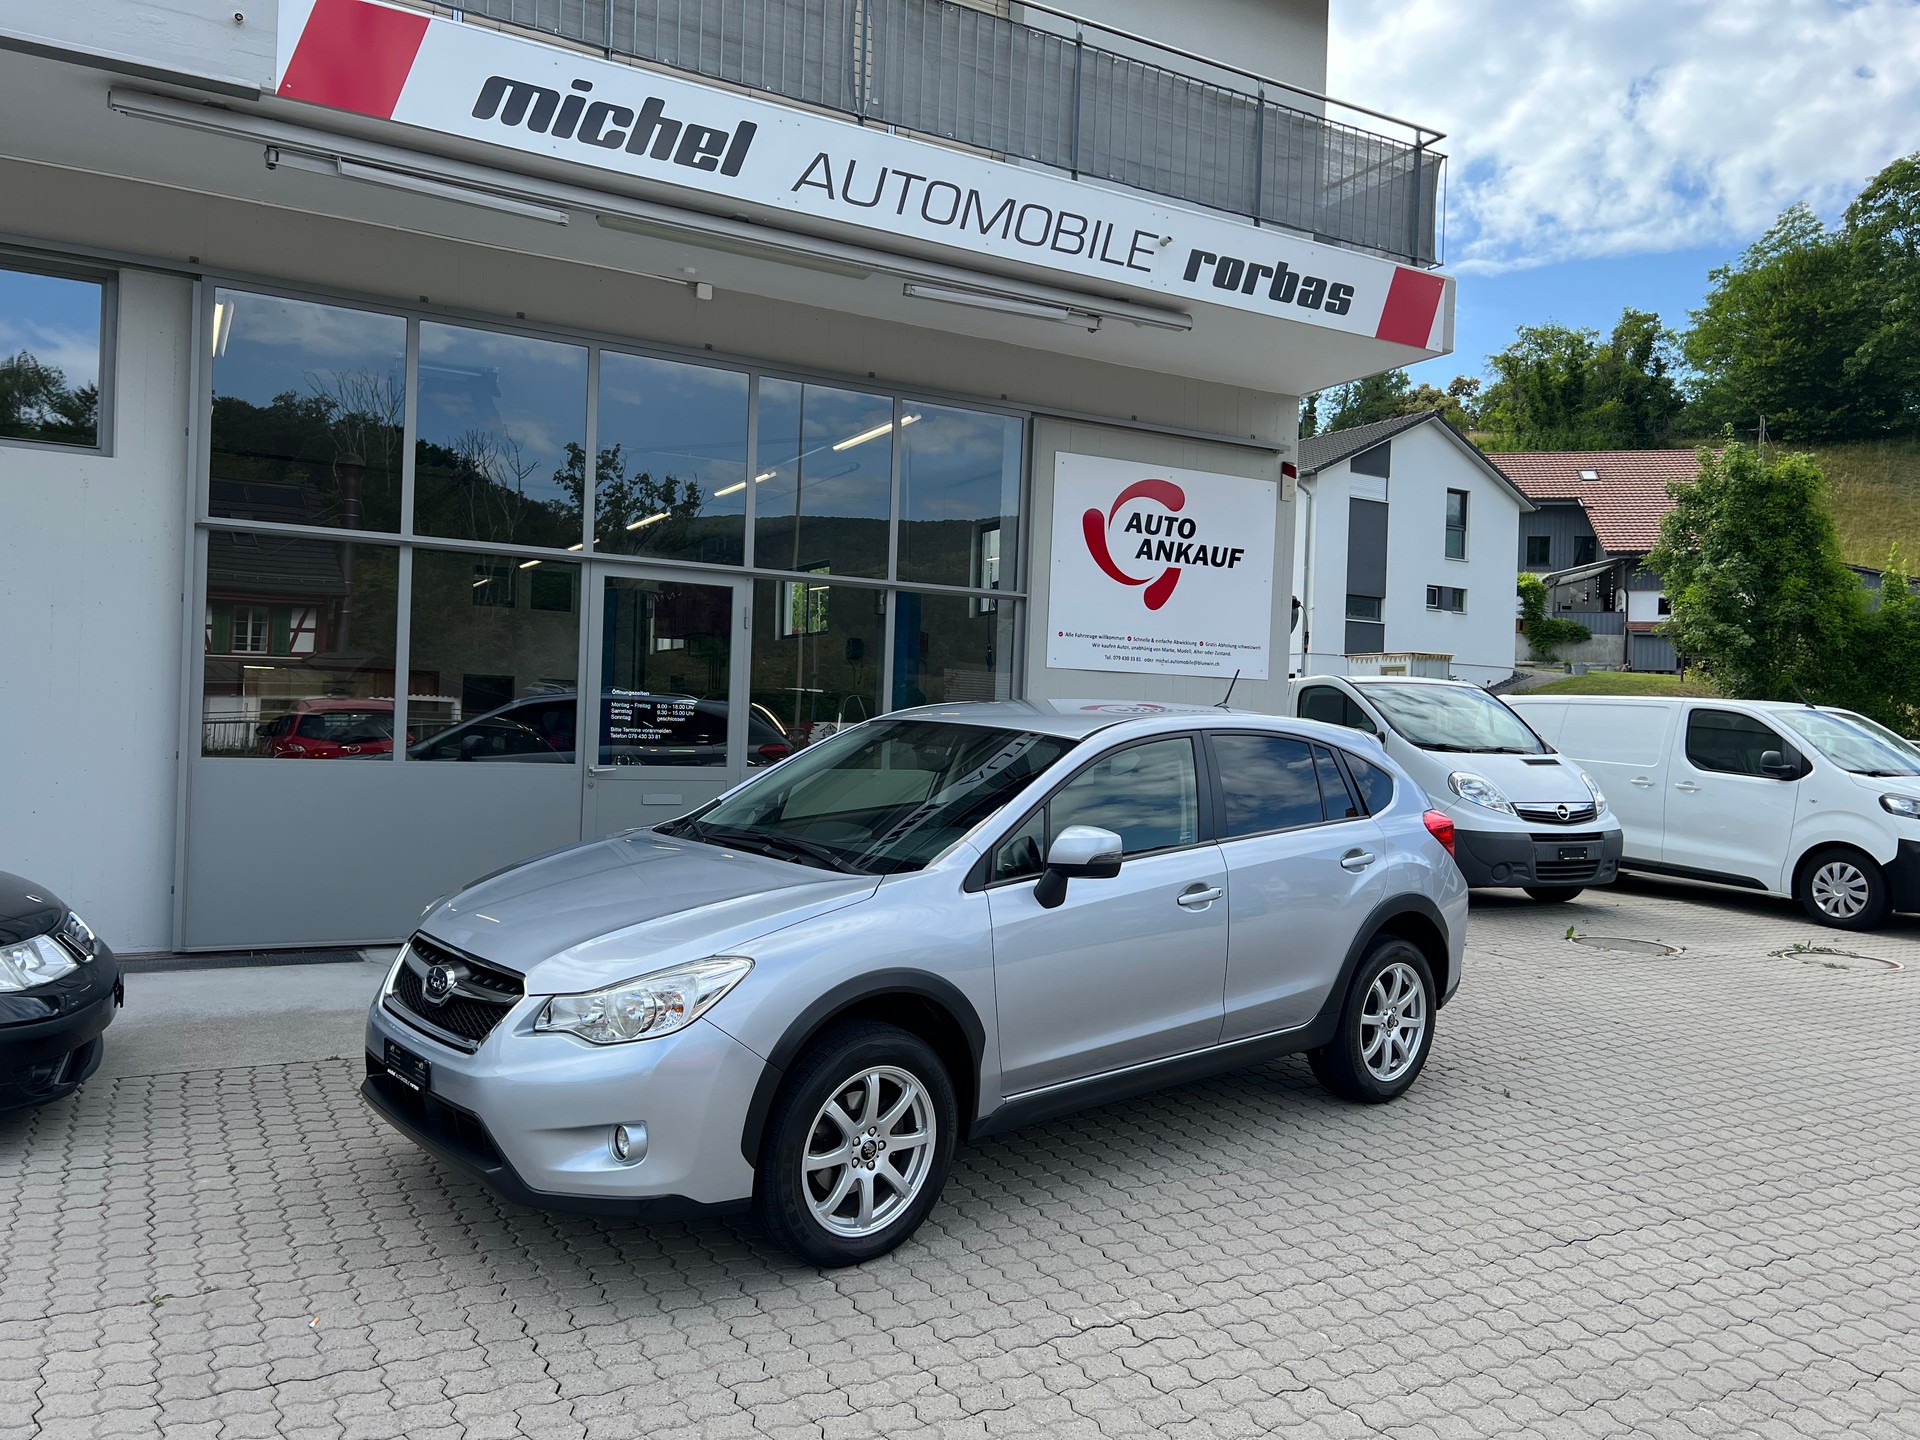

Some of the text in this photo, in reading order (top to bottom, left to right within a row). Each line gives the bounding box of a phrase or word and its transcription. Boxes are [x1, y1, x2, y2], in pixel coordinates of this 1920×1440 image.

[471, 75, 1356, 316] michel AUTOMOBILE rorbas
[1124, 512, 1196, 539] AUTO
[1135, 539, 1244, 569] ANKAUF
[1075, 632, 1098, 640] Fahrzeuge
[1173, 639, 1197, 647] Abwicklung
[611, 688, 650, 696] Öffnungszeiten
